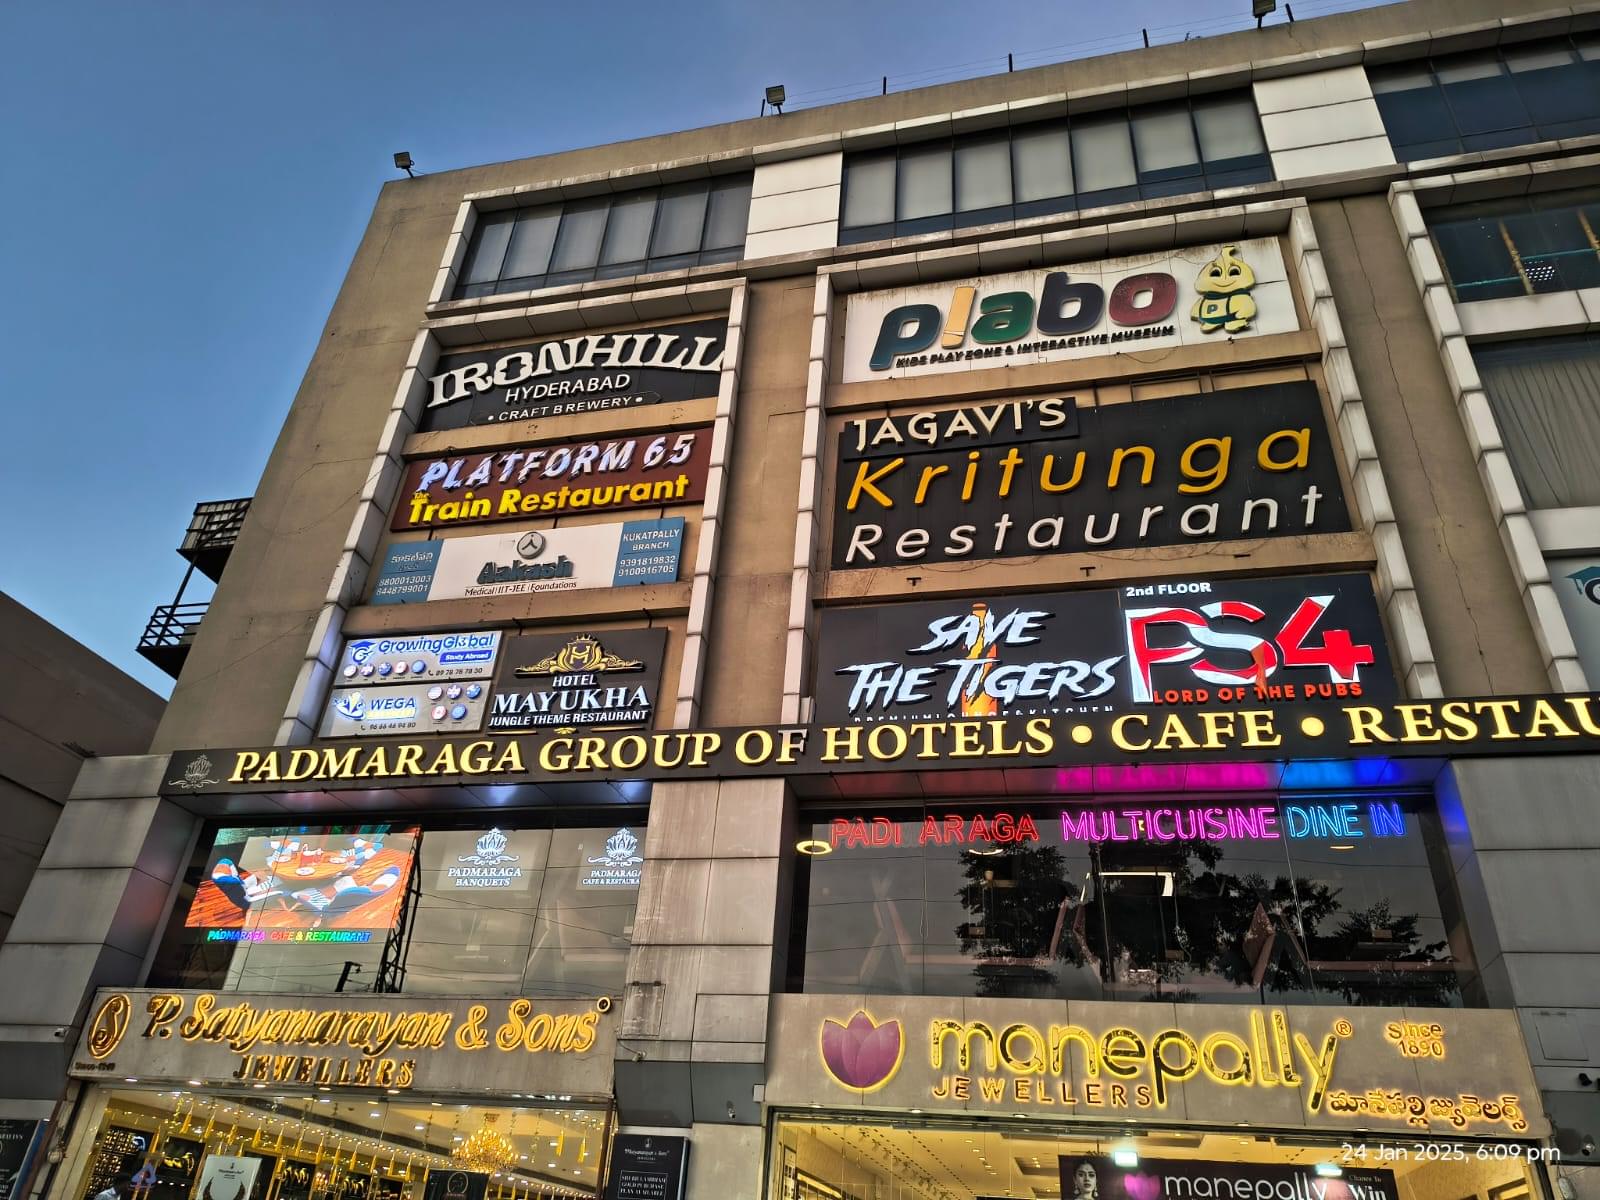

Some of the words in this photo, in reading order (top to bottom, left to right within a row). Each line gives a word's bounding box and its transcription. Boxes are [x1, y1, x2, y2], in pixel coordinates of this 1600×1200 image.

[869, 272, 1178, 371] plabo
[895, 354, 928, 369] KIDS
[929, 351, 964, 364] PLAY
[964, 346, 1002, 361] ZONE
[1005, 344, 1014, 356] &
[1016, 333, 1109, 355] INTERACTIVE
[1110, 325, 1176, 343] MUSEUM
[427, 333, 726, 408] IRONHILL
[505, 374, 631, 403] HYDERABAD
[499, 406, 549, 422] CRAFT
[553, 396, 633, 415] BREWERY
[853, 397, 1068, 452] JAGAVI'S
[416, 440, 637, 493] PLATFORM
[642, 433, 696, 471] 65
[846, 428, 1312, 511] Kritunga
[409, 491, 492, 524] Train
[498, 474, 690, 515] Restaurant
[623, 529, 680, 542] KUKATPALLY
[845, 485, 1323, 563] Restaurant
[632, 541, 670, 551] BRANCH
[618, 564, 674, 577] 9100916705
[620, 555, 676, 567] 9391819832
[530, 581, 577, 592] Foundations
[1126, 585, 1154, 597] 2nd
[1158, 582, 1212, 595] FLOOR
[907, 607, 1053, 653] SAVE
[1124, 594, 1375, 703] PS4
[552, 673, 597, 687] HOTEL
[836, 660, 944, 713] THE
[935, 655, 1126, 706] TIGERS
[1153, 688, 1209, 704] LORD
[1217, 686, 1246, 701] OF
[1255, 684, 1296, 699] THE
[1305, 682, 1363, 698] PUBS
[371, 697, 416, 710] WEGA
[491, 685, 650, 714] MAYUKHA
[489, 715, 531, 727] JUNGLE
[533, 713, 571, 725] THEME
[572, 710, 649, 723] RESTAURANT
[228, 740, 526, 783] PADMARAGA
[539, 732, 721, 771] GROUP
[735, 728, 808, 764] OF
[820, 718, 1054, 762] HOTELS
[1110, 708, 1284, 751] CAFE
[1342, 697, 1600, 744] RESTAU
[1061, 807, 1281, 841] MULTICUISINE
[1286, 804, 1364, 838] DINE
[1368, 802, 1406, 837] IN
[447, 867, 522, 877] PADMARAGA
[456, 878, 511, 887] BANQUETS
[271, 930, 294, 941] CAFE
[295, 930, 304, 941] &
[305, 930, 373, 942] RESTAURANT
[141, 994, 185, 1040] P.
[180, 993, 455, 1057] Satyanarayan
[455, 1004, 489, 1052] &
[496, 998, 599, 1053] Sons
[1386, 1020, 1443, 1041] Since
[931, 1009, 1338, 1112] manepally
[1399, 1039, 1444, 1058] 1890
[233, 1054, 417, 1088] JEWELLERS
[933, 1076, 1152, 1107] JEWELLERS
